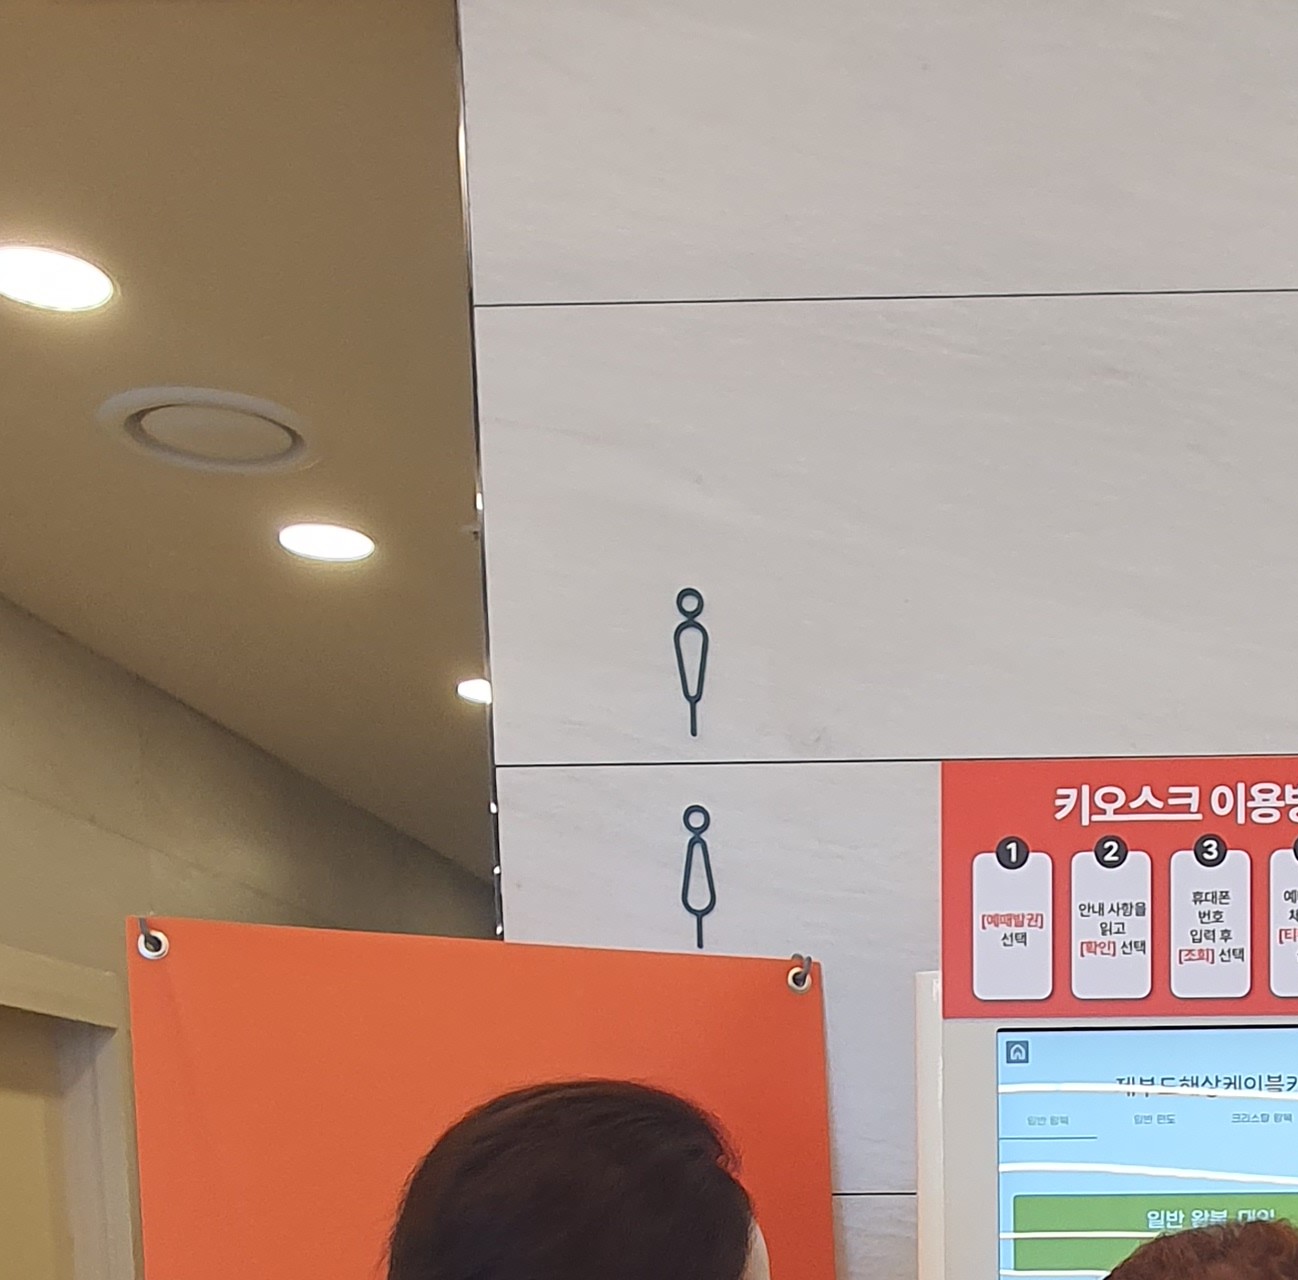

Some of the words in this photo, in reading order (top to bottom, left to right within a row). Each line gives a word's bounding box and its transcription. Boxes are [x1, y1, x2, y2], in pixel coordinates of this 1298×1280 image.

[1054, 783, 1203, 827] 키오스크
[1191, 890, 1231, 905] 휴대폰
[1078, 902, 1104, 917] 안내
[1108, 901, 1147, 917] 사항을
[1198, 910, 1225, 925] 번호
[1099, 921, 1127, 936] 읽고
[1001, 932, 1028, 947] 선택
[1190, 929, 1216, 944] 입력
[1219, 929, 1233, 943] 후
[1120, 940, 1147, 955] 선택
[1219, 947, 1246, 963] 선택
[1146, 1209, 1186, 1229] 일반
